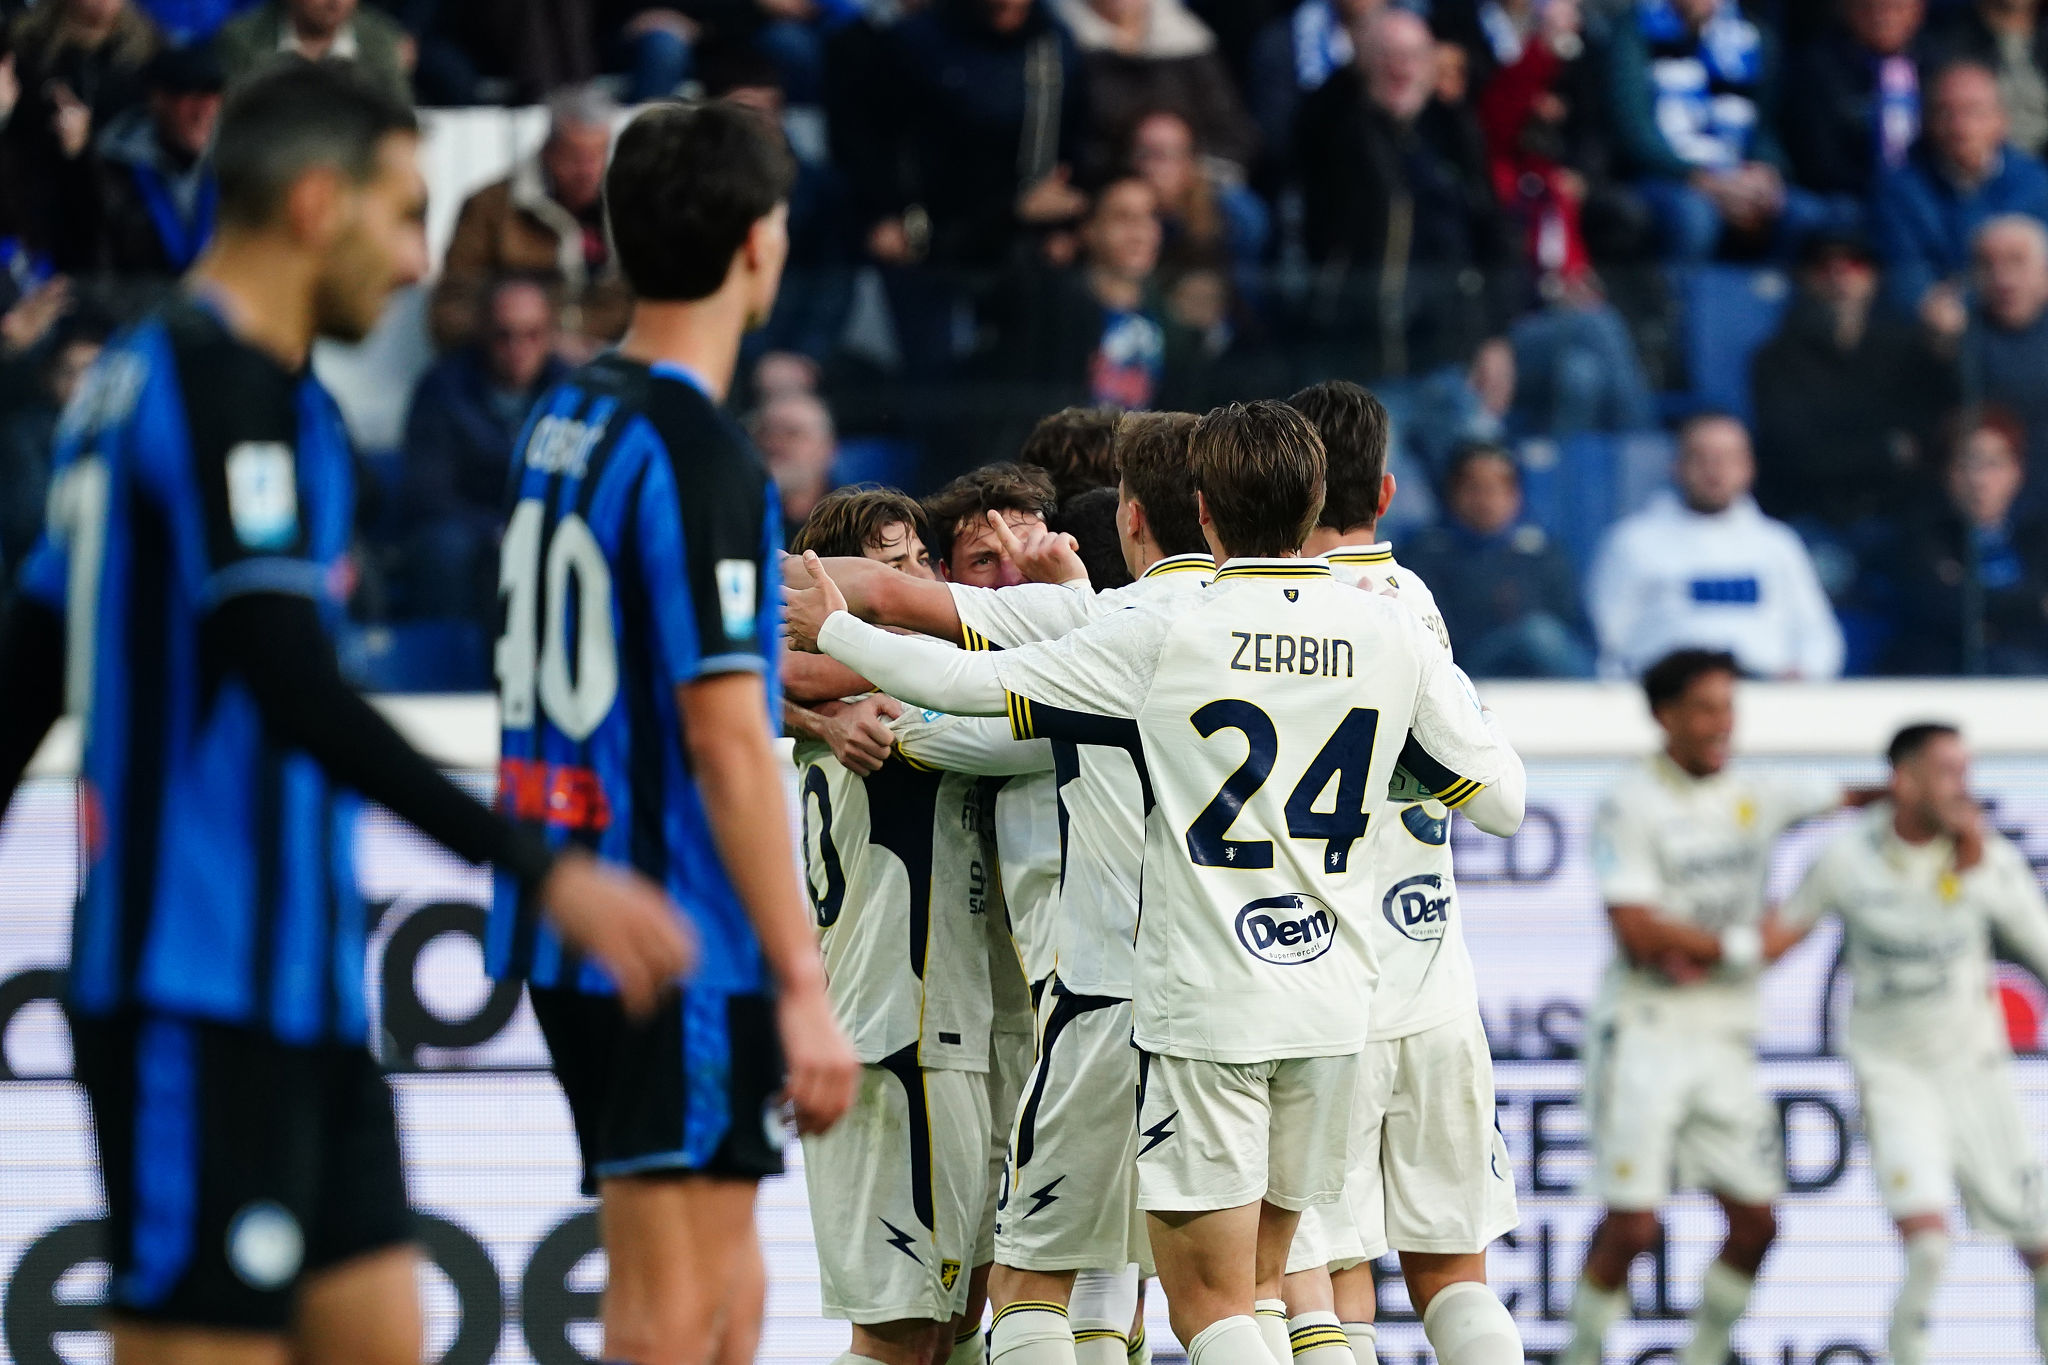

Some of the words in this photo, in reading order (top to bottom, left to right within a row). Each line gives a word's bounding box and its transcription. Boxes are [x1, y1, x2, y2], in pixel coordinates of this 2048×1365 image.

[1230, 631, 1353, 678] ZERBIN
[1186, 698, 1380, 875] 24
[1246, 909, 1330, 951] Dem
